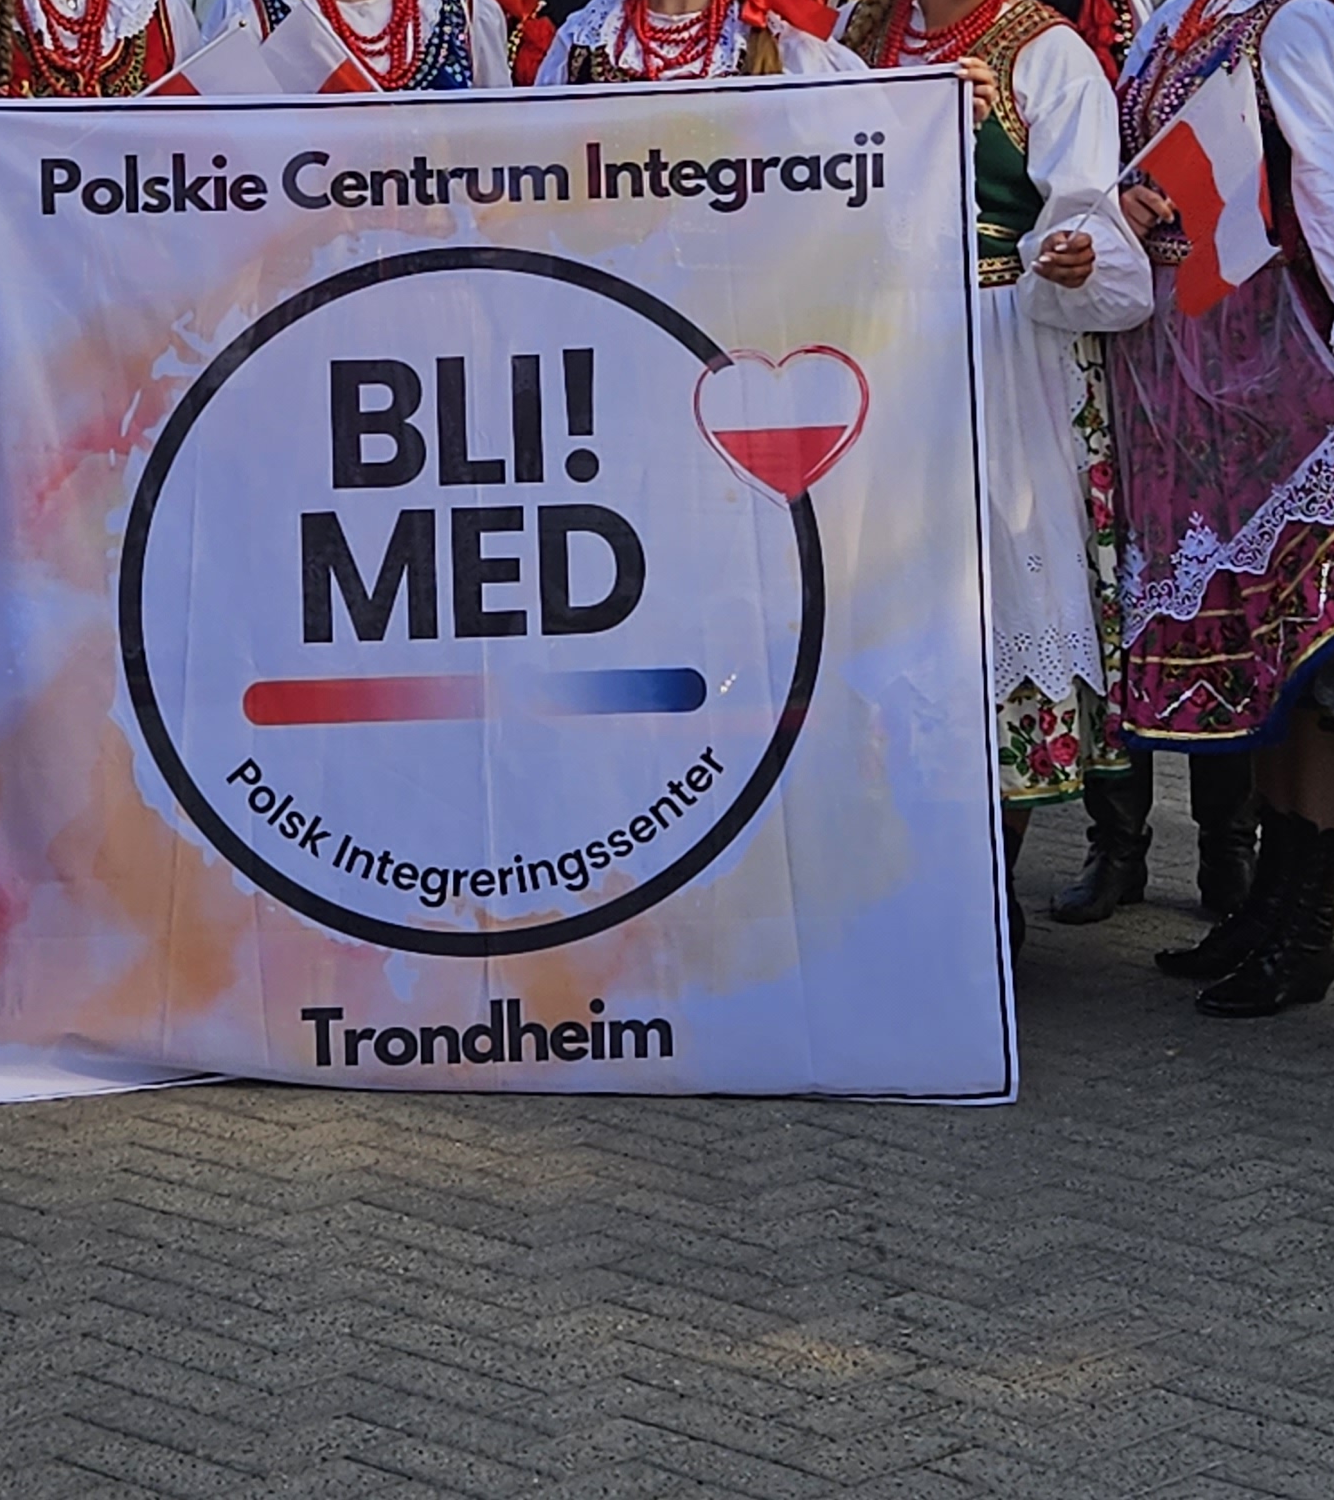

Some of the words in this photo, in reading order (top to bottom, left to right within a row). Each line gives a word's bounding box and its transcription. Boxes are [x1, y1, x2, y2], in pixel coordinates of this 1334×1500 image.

[40, 152, 268, 216] Polskie
[281, 150, 570, 210] Centrum
[586, 131, 886, 213] Integracji
[330, 348, 600, 491] BLI!
[300, 503, 647, 645] MED
[226, 757, 332, 859] Polsk
[331, 745, 726, 908] Integreringssenter
[301, 998, 674, 1068] Trondheim
